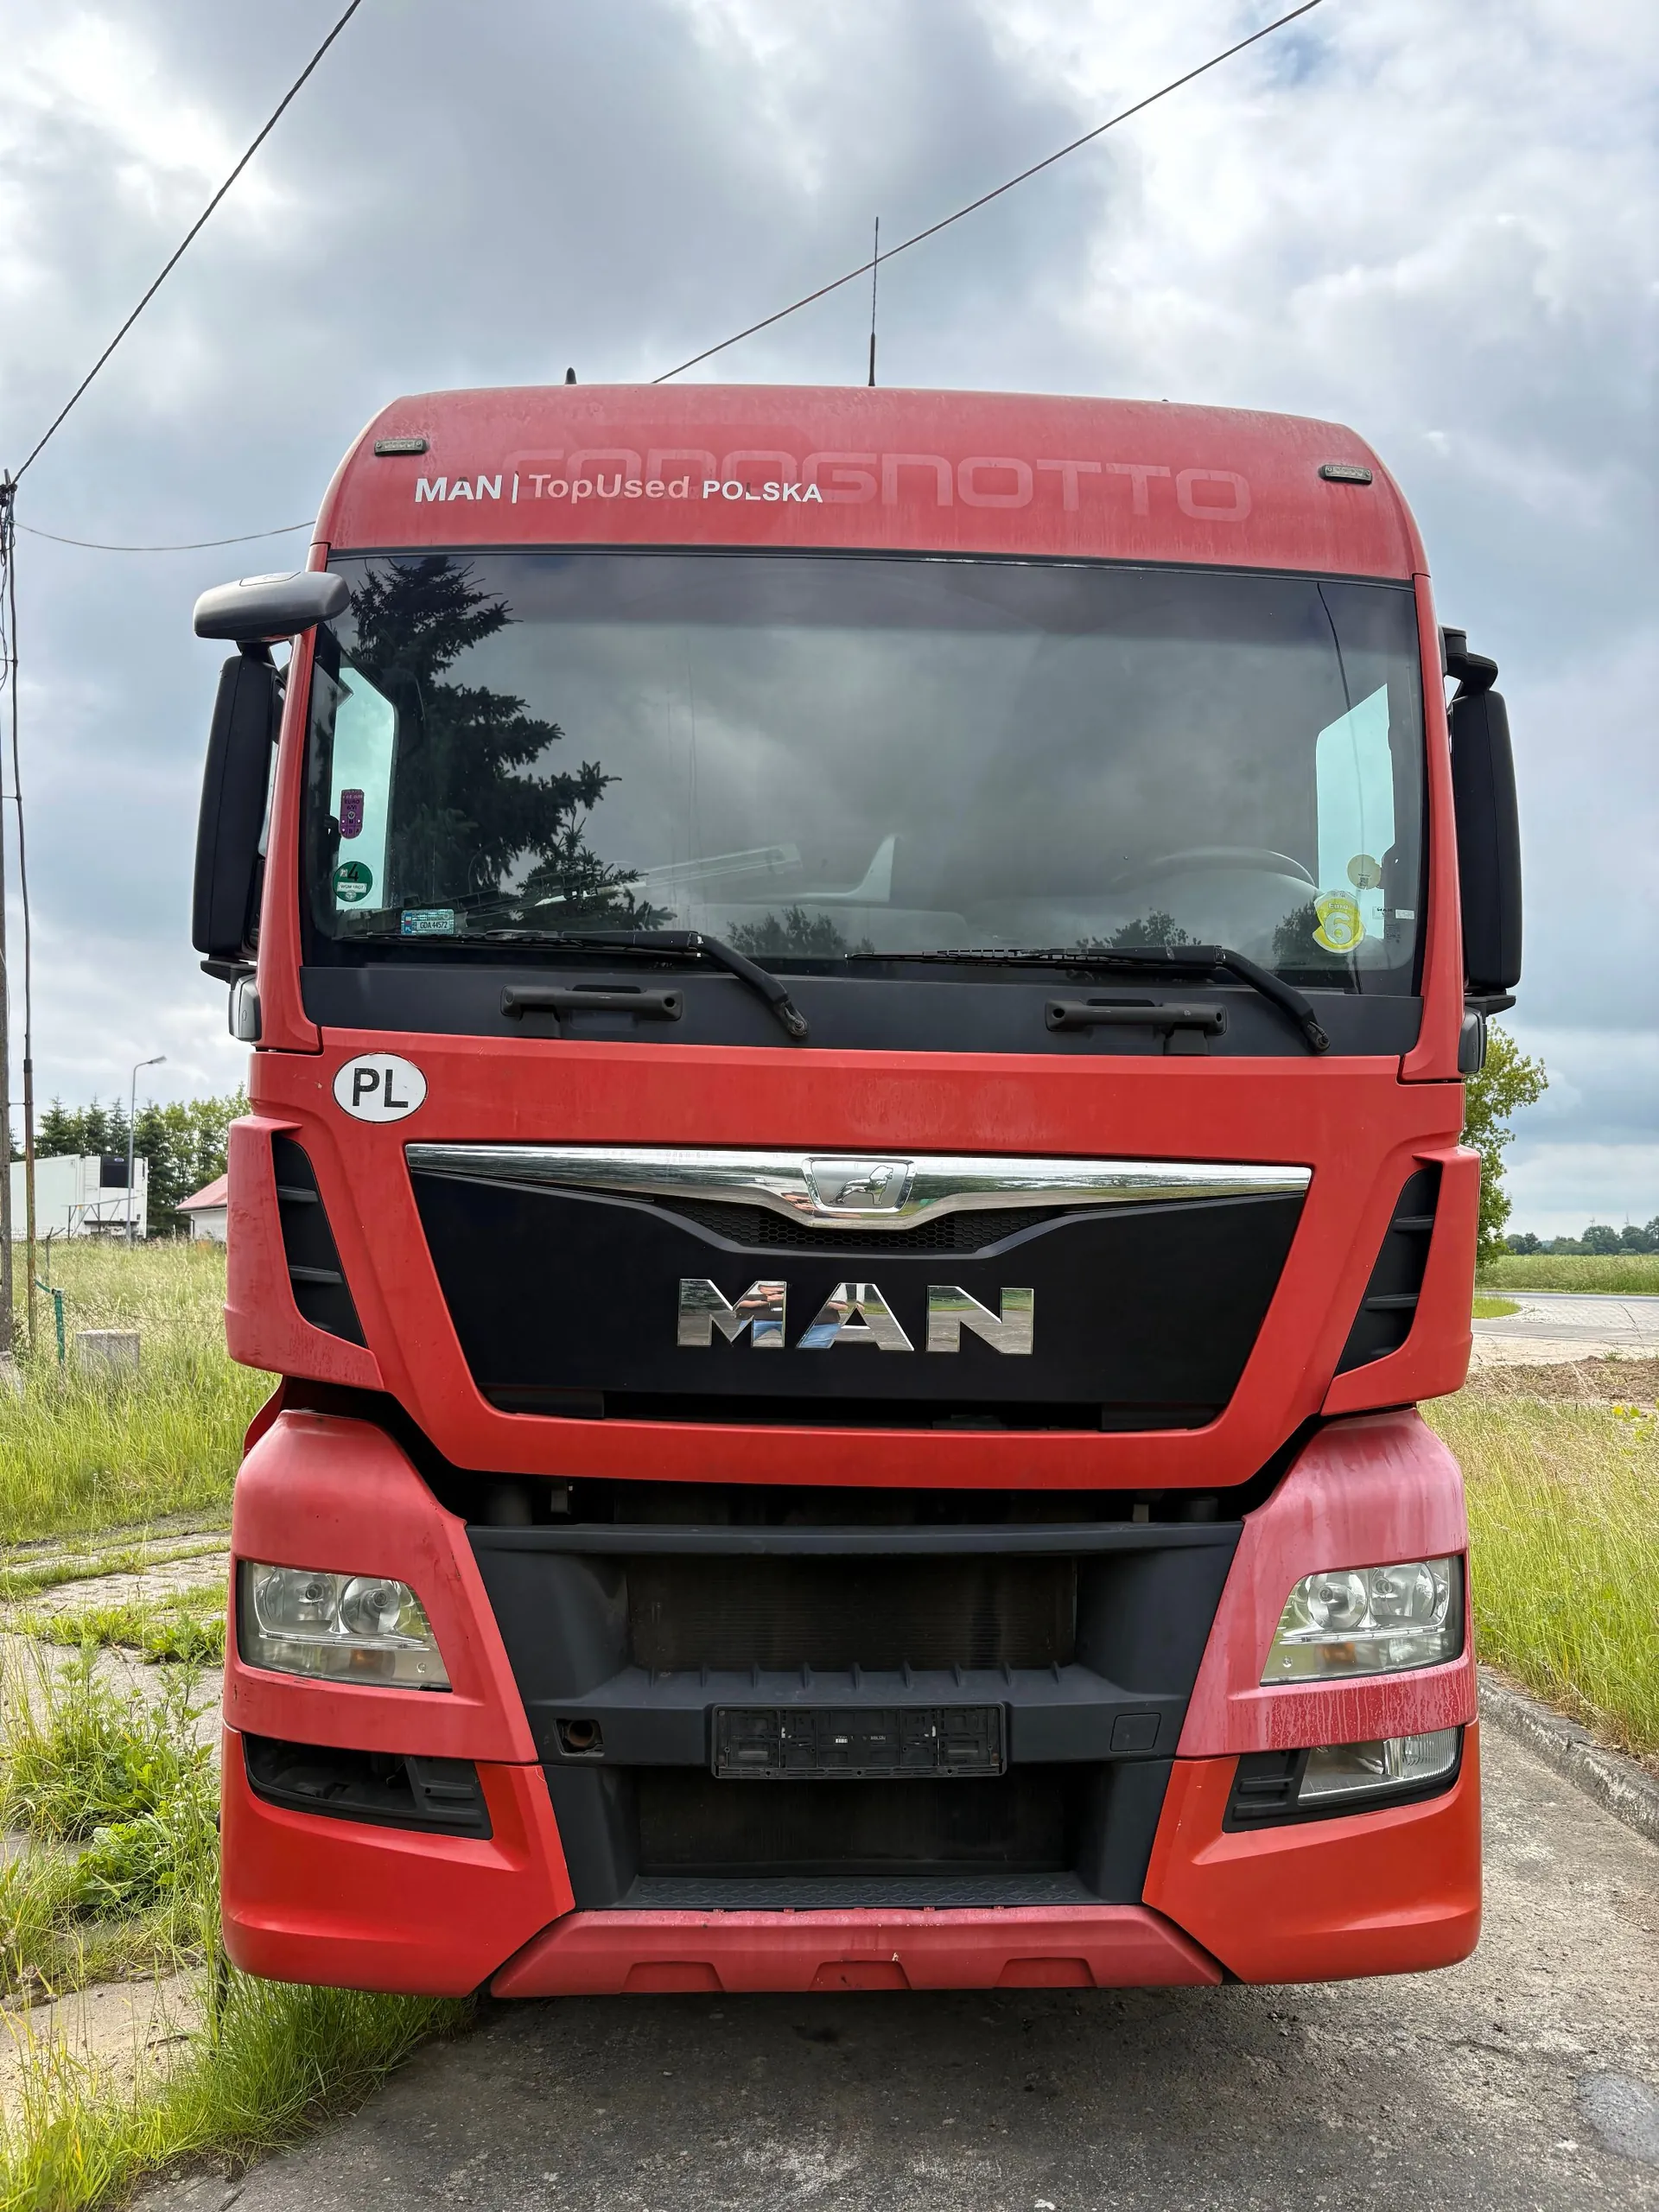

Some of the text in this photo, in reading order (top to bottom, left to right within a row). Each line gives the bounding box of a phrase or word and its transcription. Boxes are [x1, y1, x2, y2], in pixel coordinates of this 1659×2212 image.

[415, 473, 823, 504] MAN TopUsed POLSKA
[347, 863, 359, 881] 4
[1325, 911, 1352, 945] 6
[352, 1067, 409, 1108] PL
[677, 1278, 1034, 1355] MAN
